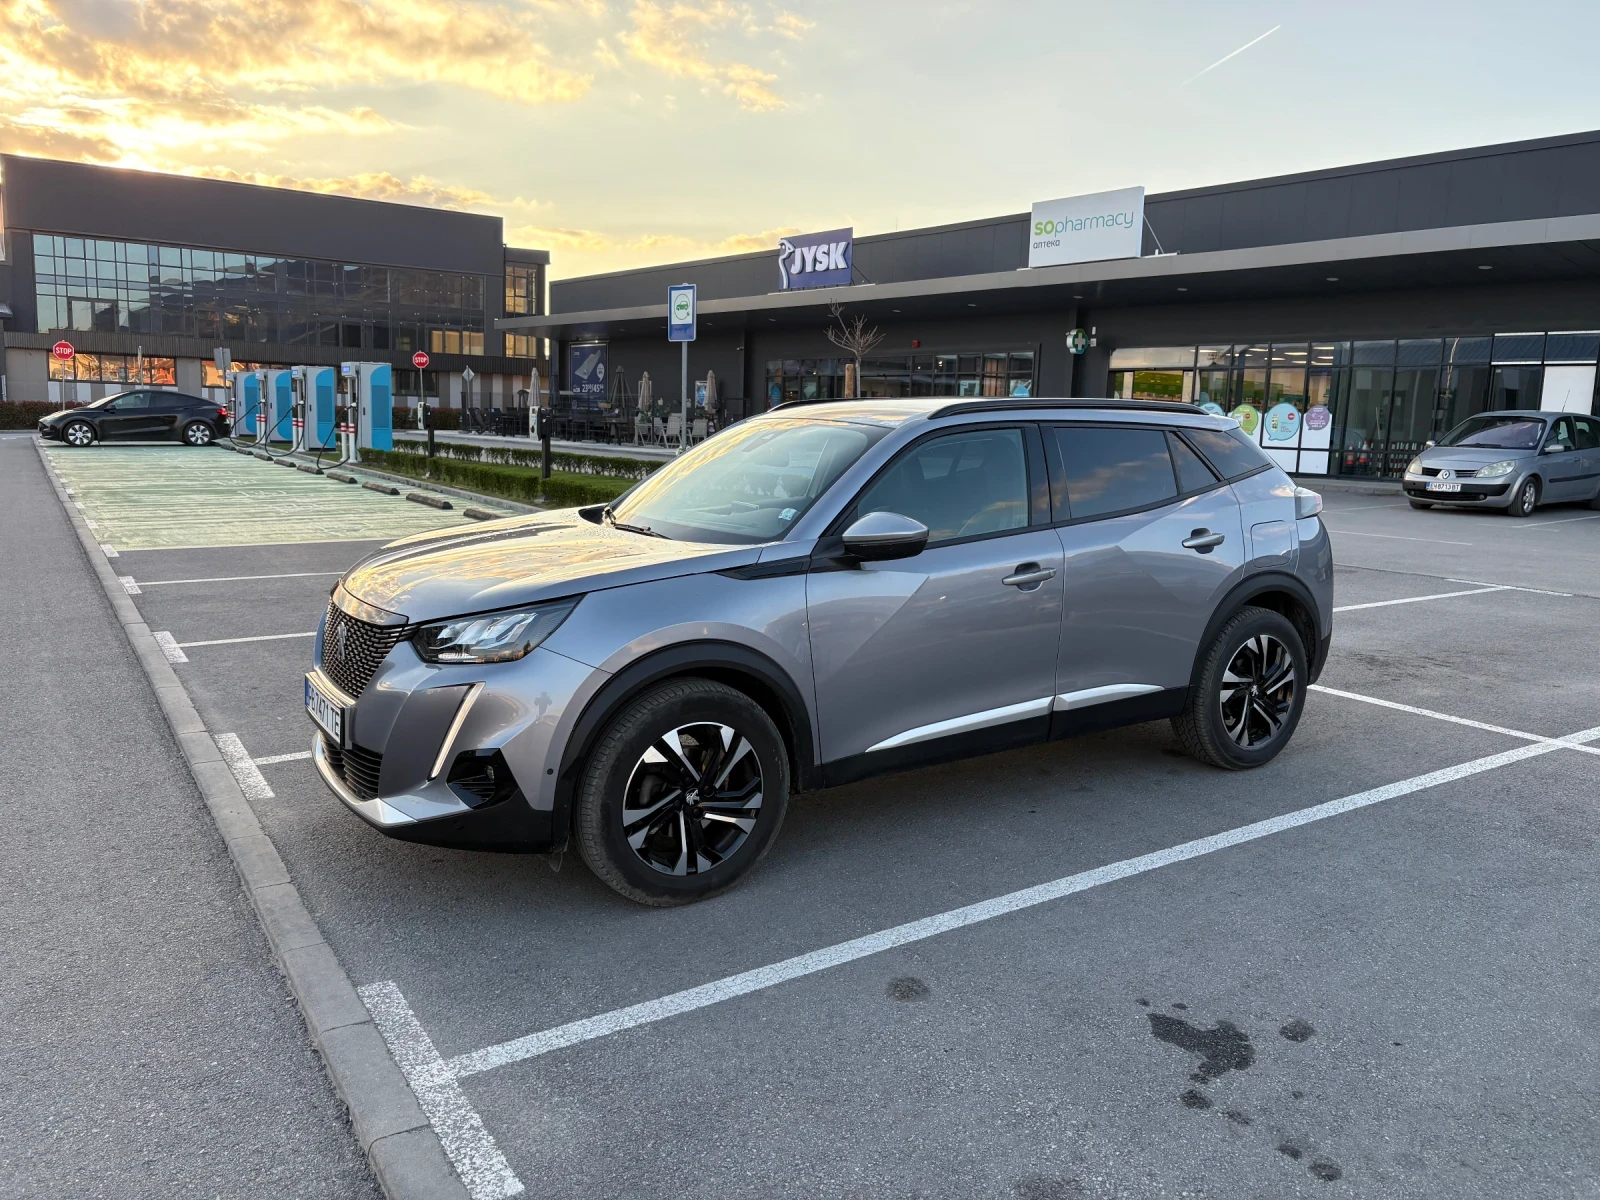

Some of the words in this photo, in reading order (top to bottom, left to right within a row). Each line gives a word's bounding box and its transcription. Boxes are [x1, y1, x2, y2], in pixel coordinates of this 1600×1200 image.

[1034, 211, 1134, 238] sopharmacy
[1033, 239, 1061, 250] аптека
[790, 241, 849, 275] JYSK
[55, 347, 72, 355] STOP
[414, 356, 428, 364] STOP
